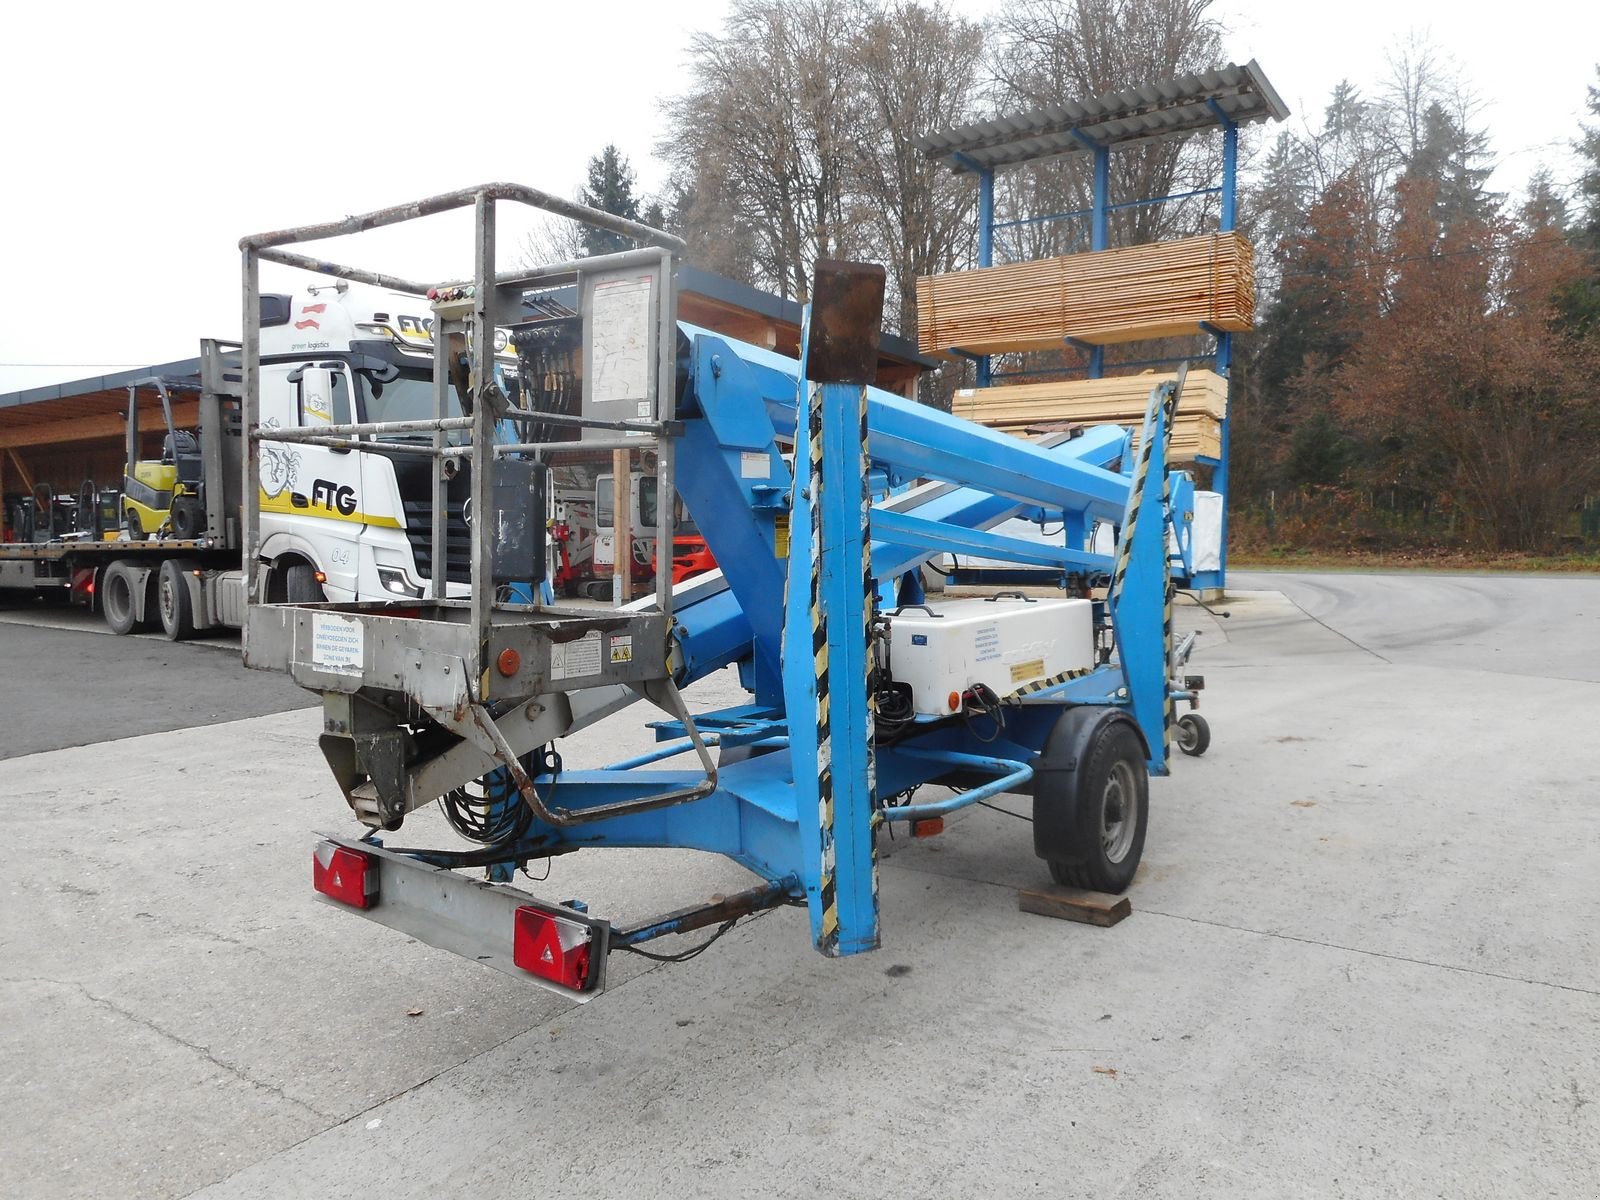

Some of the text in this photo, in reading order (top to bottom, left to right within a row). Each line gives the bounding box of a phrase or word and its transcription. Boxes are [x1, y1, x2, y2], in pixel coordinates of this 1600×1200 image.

[291, 341, 329, 351] green logistics
[312, 478, 357, 515] FTG
[331, 547, 350, 565] 04
